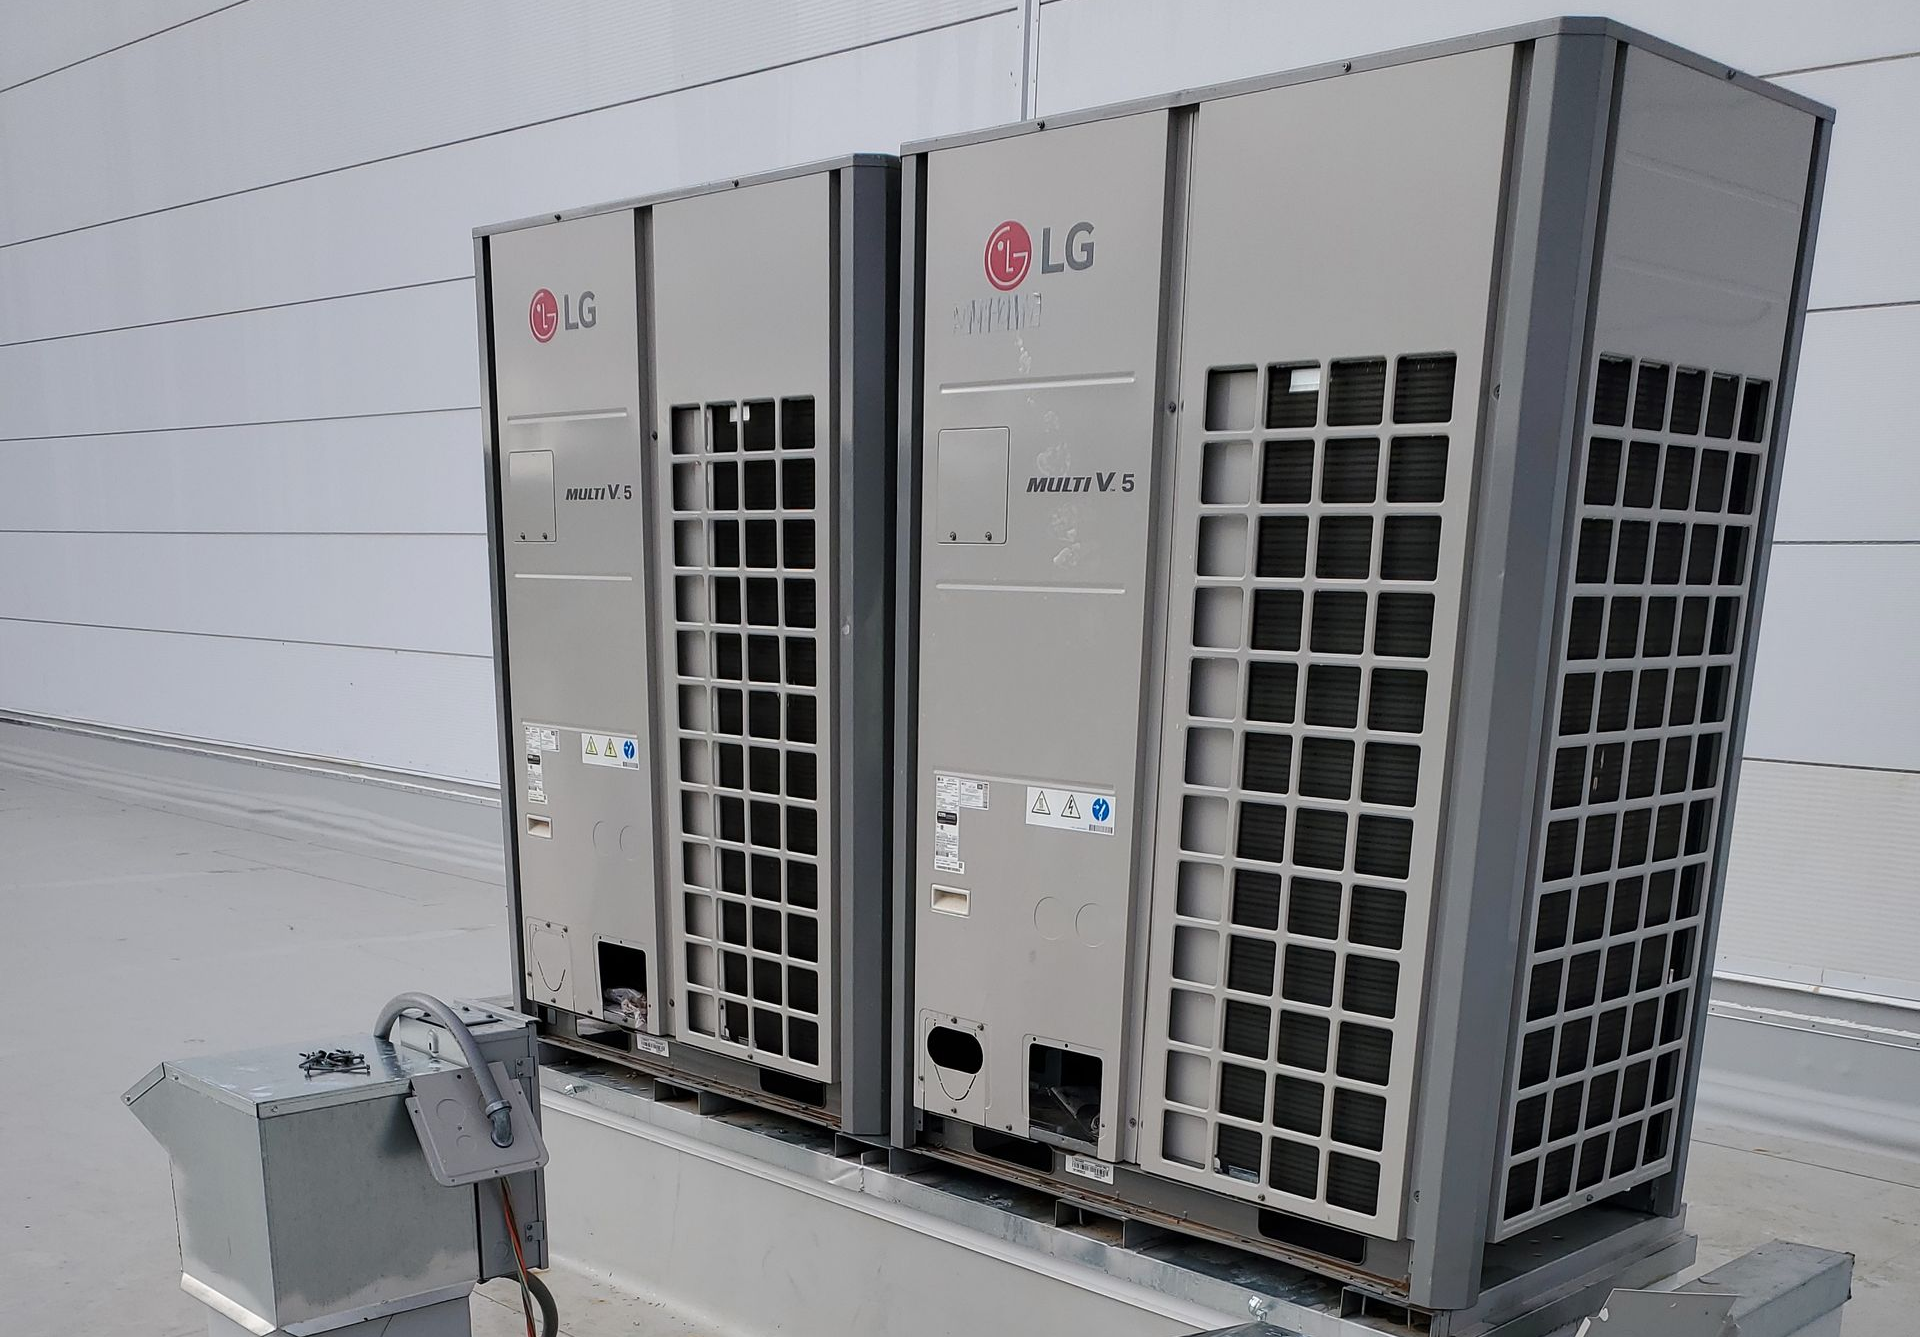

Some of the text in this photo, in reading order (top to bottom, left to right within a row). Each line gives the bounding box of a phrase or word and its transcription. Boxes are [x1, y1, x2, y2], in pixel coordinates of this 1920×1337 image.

[1042, 221, 1095, 275] LG
[564, 291, 597, 331] LG
[565, 487, 606, 500] MULTI
[624, 485, 632, 500] 5
[1026, 477, 1092, 492] MULTI
[1121, 474, 1135, 492] 5
